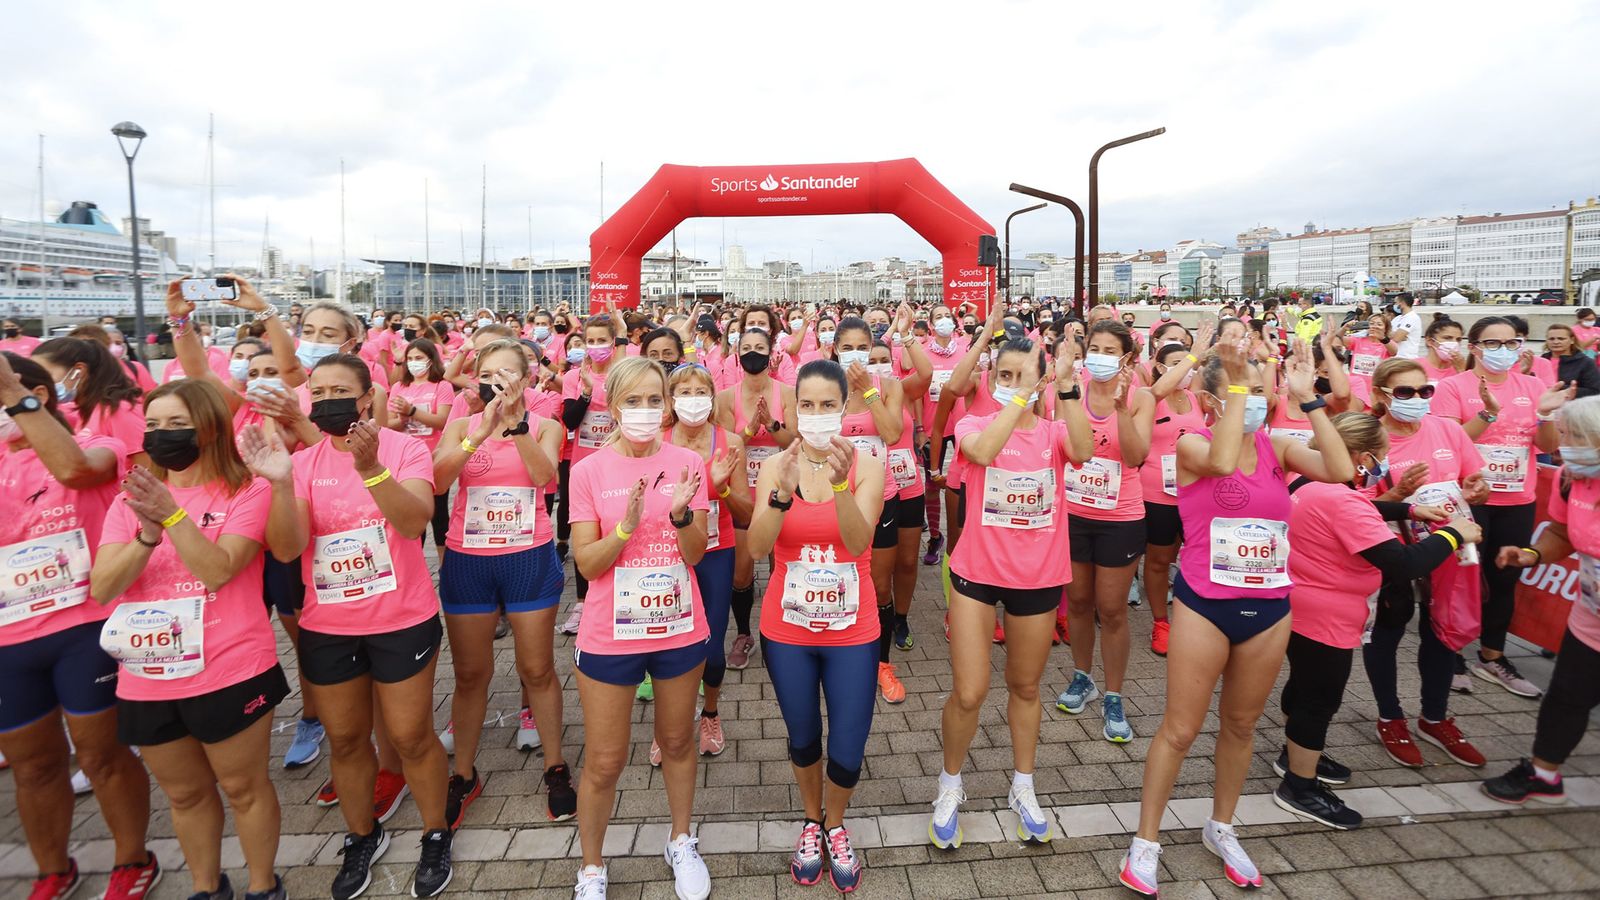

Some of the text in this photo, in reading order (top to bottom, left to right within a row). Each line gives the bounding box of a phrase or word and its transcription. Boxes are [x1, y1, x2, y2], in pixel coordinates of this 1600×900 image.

[711, 175, 860, 195] Sports Santander
[596, 271, 619, 279] Sports
[960, 269, 982, 277] Sports
[595, 282, 630, 290] Santander
[591, 425, 610, 434] 016
[1488, 463, 1514, 472] 016
[1080, 474, 1103, 487] 016
[1006, 493, 1037, 505] 016
[41, 504, 76, 519] POR
[487, 510, 514, 522] 016
[648, 543, 678, 553] TODA
[1238, 544, 1270, 559] 016
[330, 557, 365, 573] 016
[624, 556, 683, 568] NOSOTRAS
[14, 564, 58, 587] 016
[174, 581, 206, 593] TOD
[640, 594, 673, 608] 016
[805, 590, 837, 602] 016
[130, 632, 171, 648] 016
